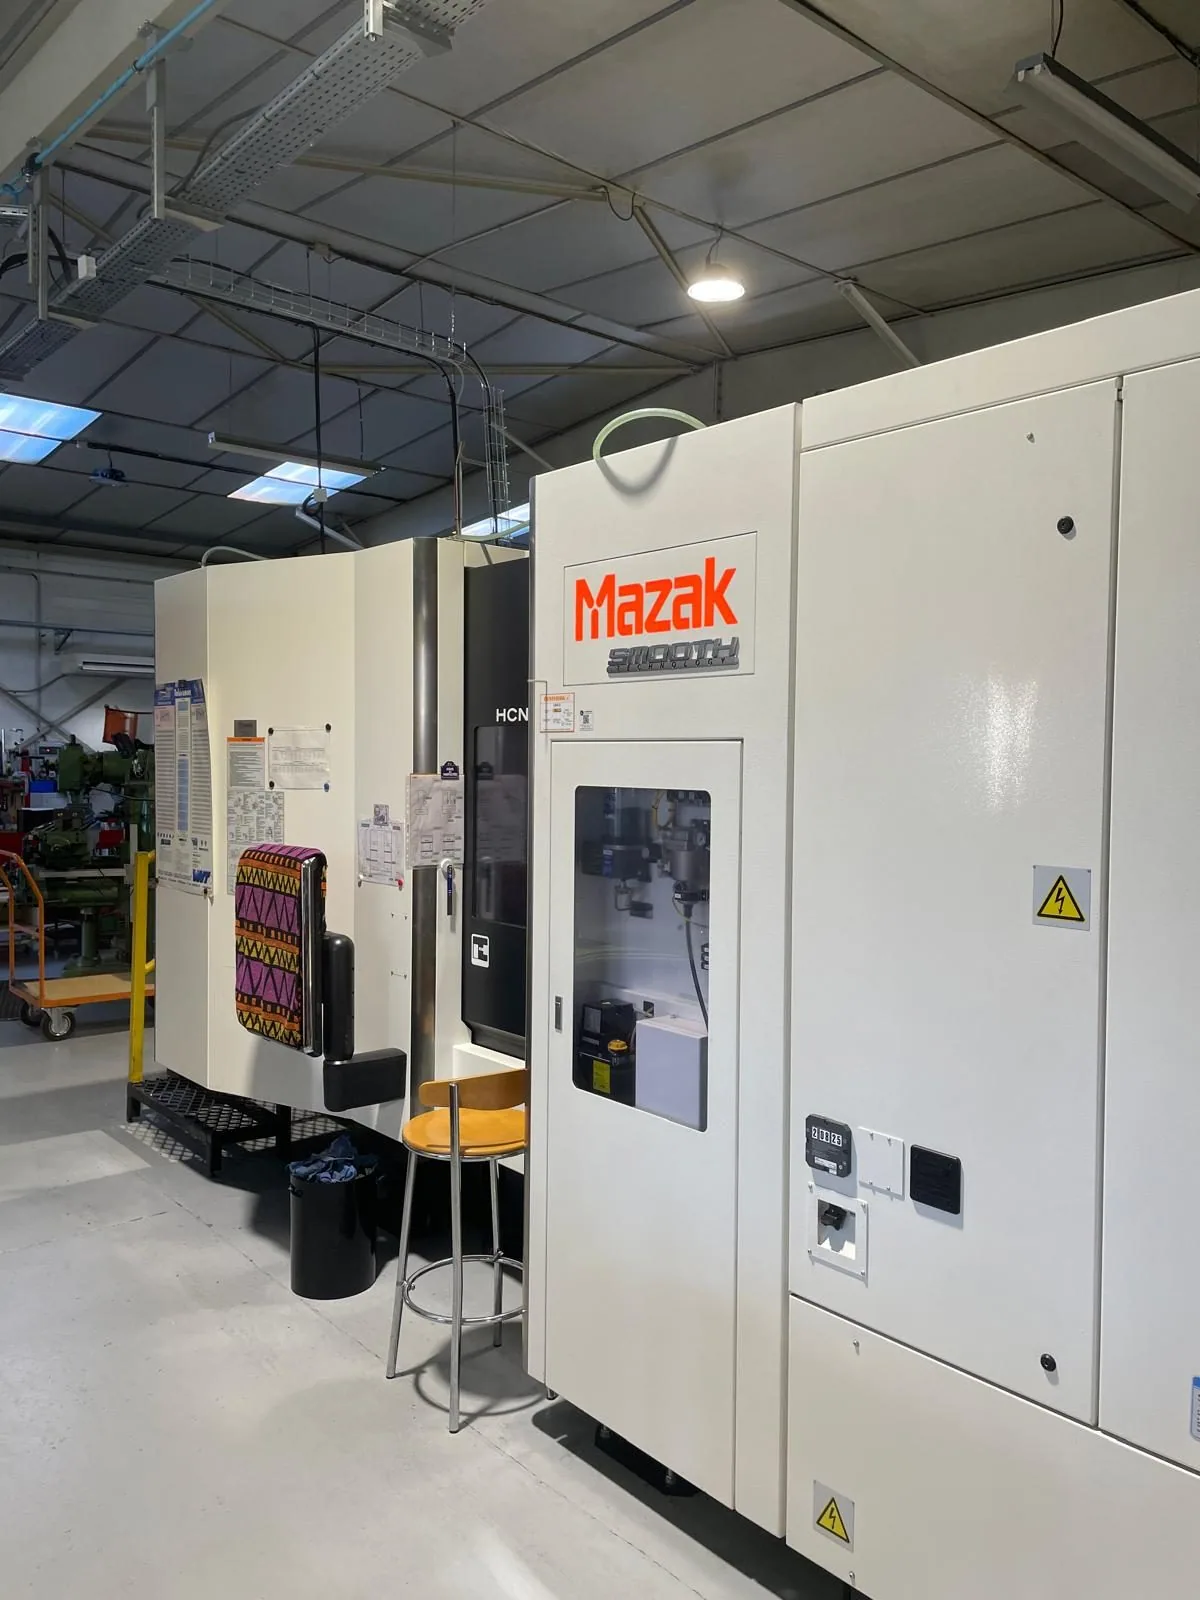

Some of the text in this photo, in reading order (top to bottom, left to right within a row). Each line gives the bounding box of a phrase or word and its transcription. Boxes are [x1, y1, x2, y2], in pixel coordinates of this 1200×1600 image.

[575, 556, 738, 642] Mazak
[608, 636, 740, 666] SMOOTH
[495, 706, 528, 723] HCN
